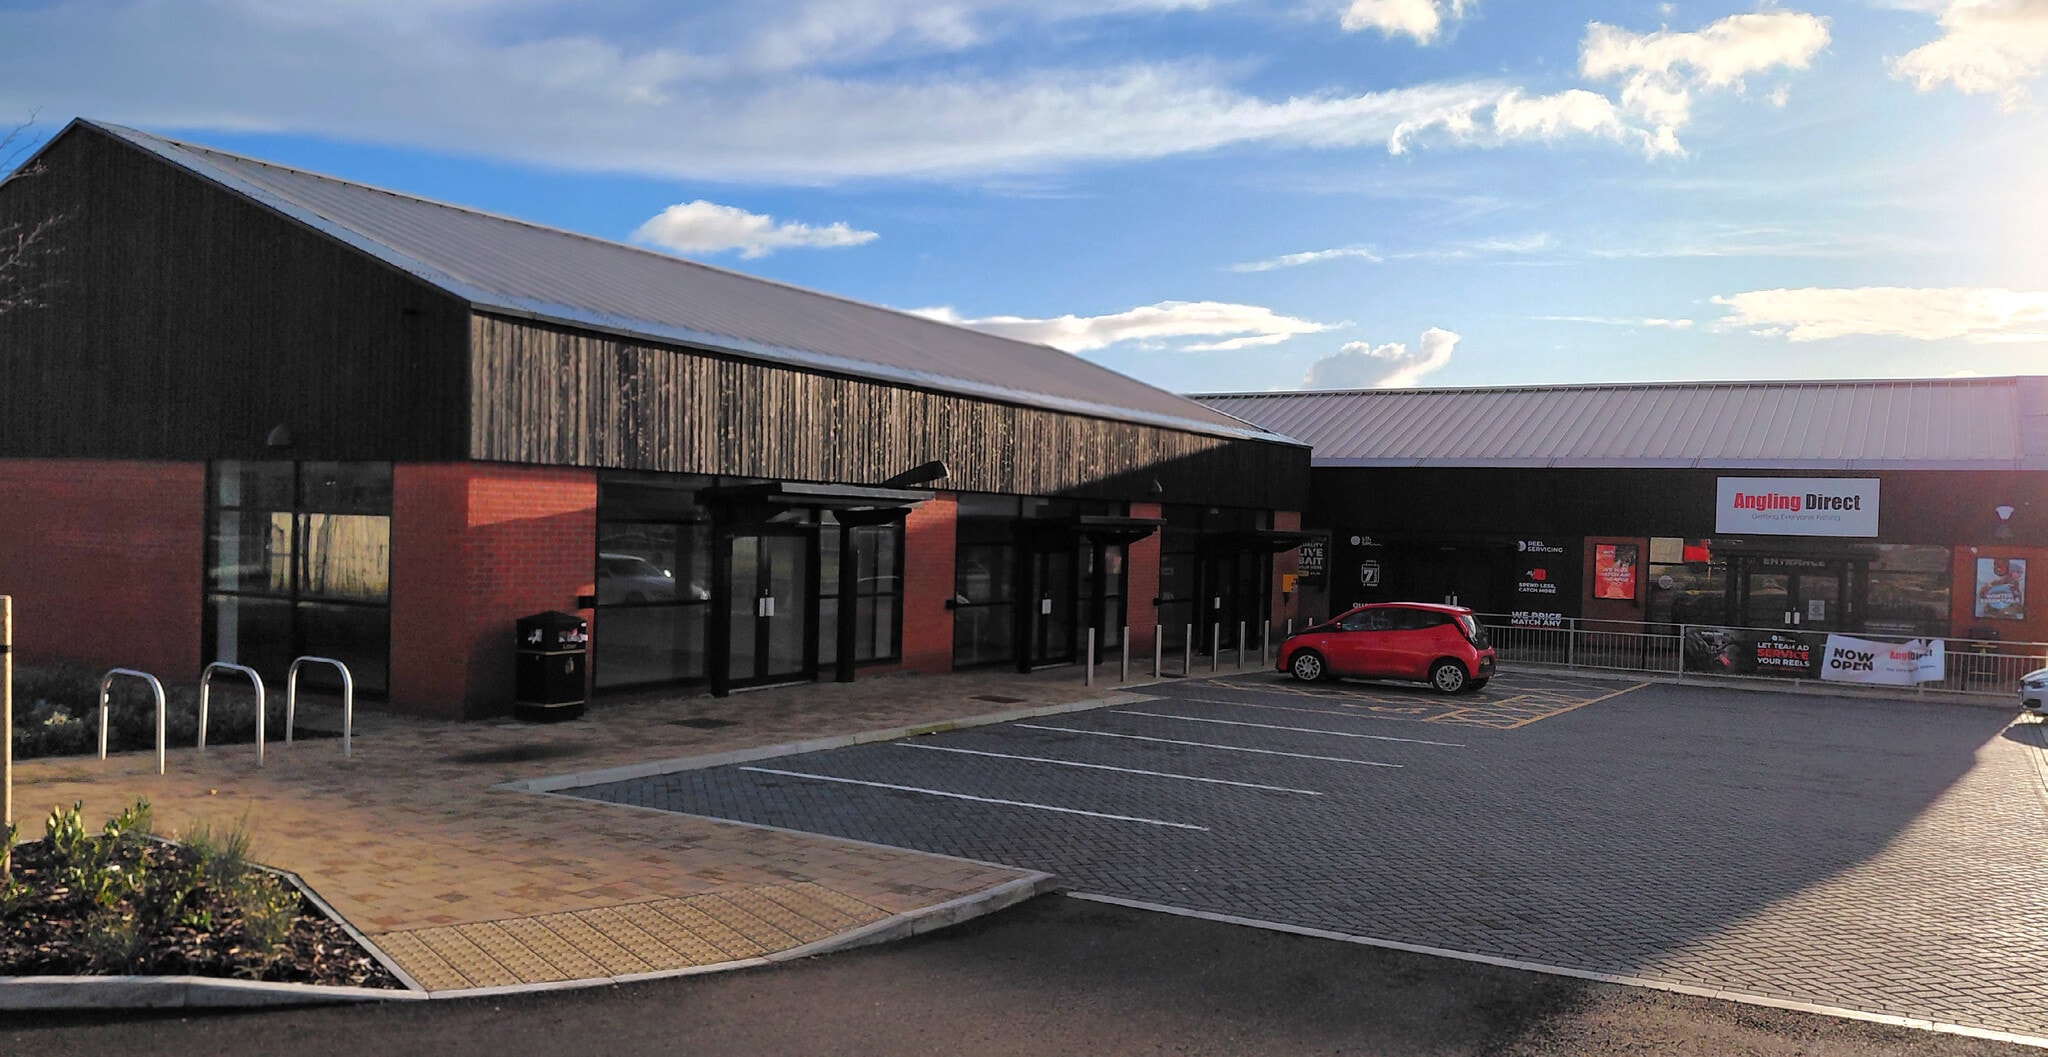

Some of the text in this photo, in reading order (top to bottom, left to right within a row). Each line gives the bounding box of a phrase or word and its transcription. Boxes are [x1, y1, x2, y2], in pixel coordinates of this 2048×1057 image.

[1734, 492, 1861, 512] Angling Direct
[1752, 513, 1779, 521] Getting
[1780, 513, 1815, 521] Everyone
[1299, 547, 1323, 557] LIVE
[1299, 556, 1323, 565] BAIT
[1763, 558, 1826, 567] ENTRANCE
[1363, 569, 1374, 583] 7
[1511, 611, 1562, 621] WE PRICE
[1511, 618, 1562, 627] MATCH ANY
[1774, 642, 1795, 650] TEAM
[1757, 648, 1809, 660] SERVICE
[1833, 647, 1875, 662] NOW
[1757, 657, 1810, 667] YOUR REELS
[1830, 659, 1874, 671] OPEN
